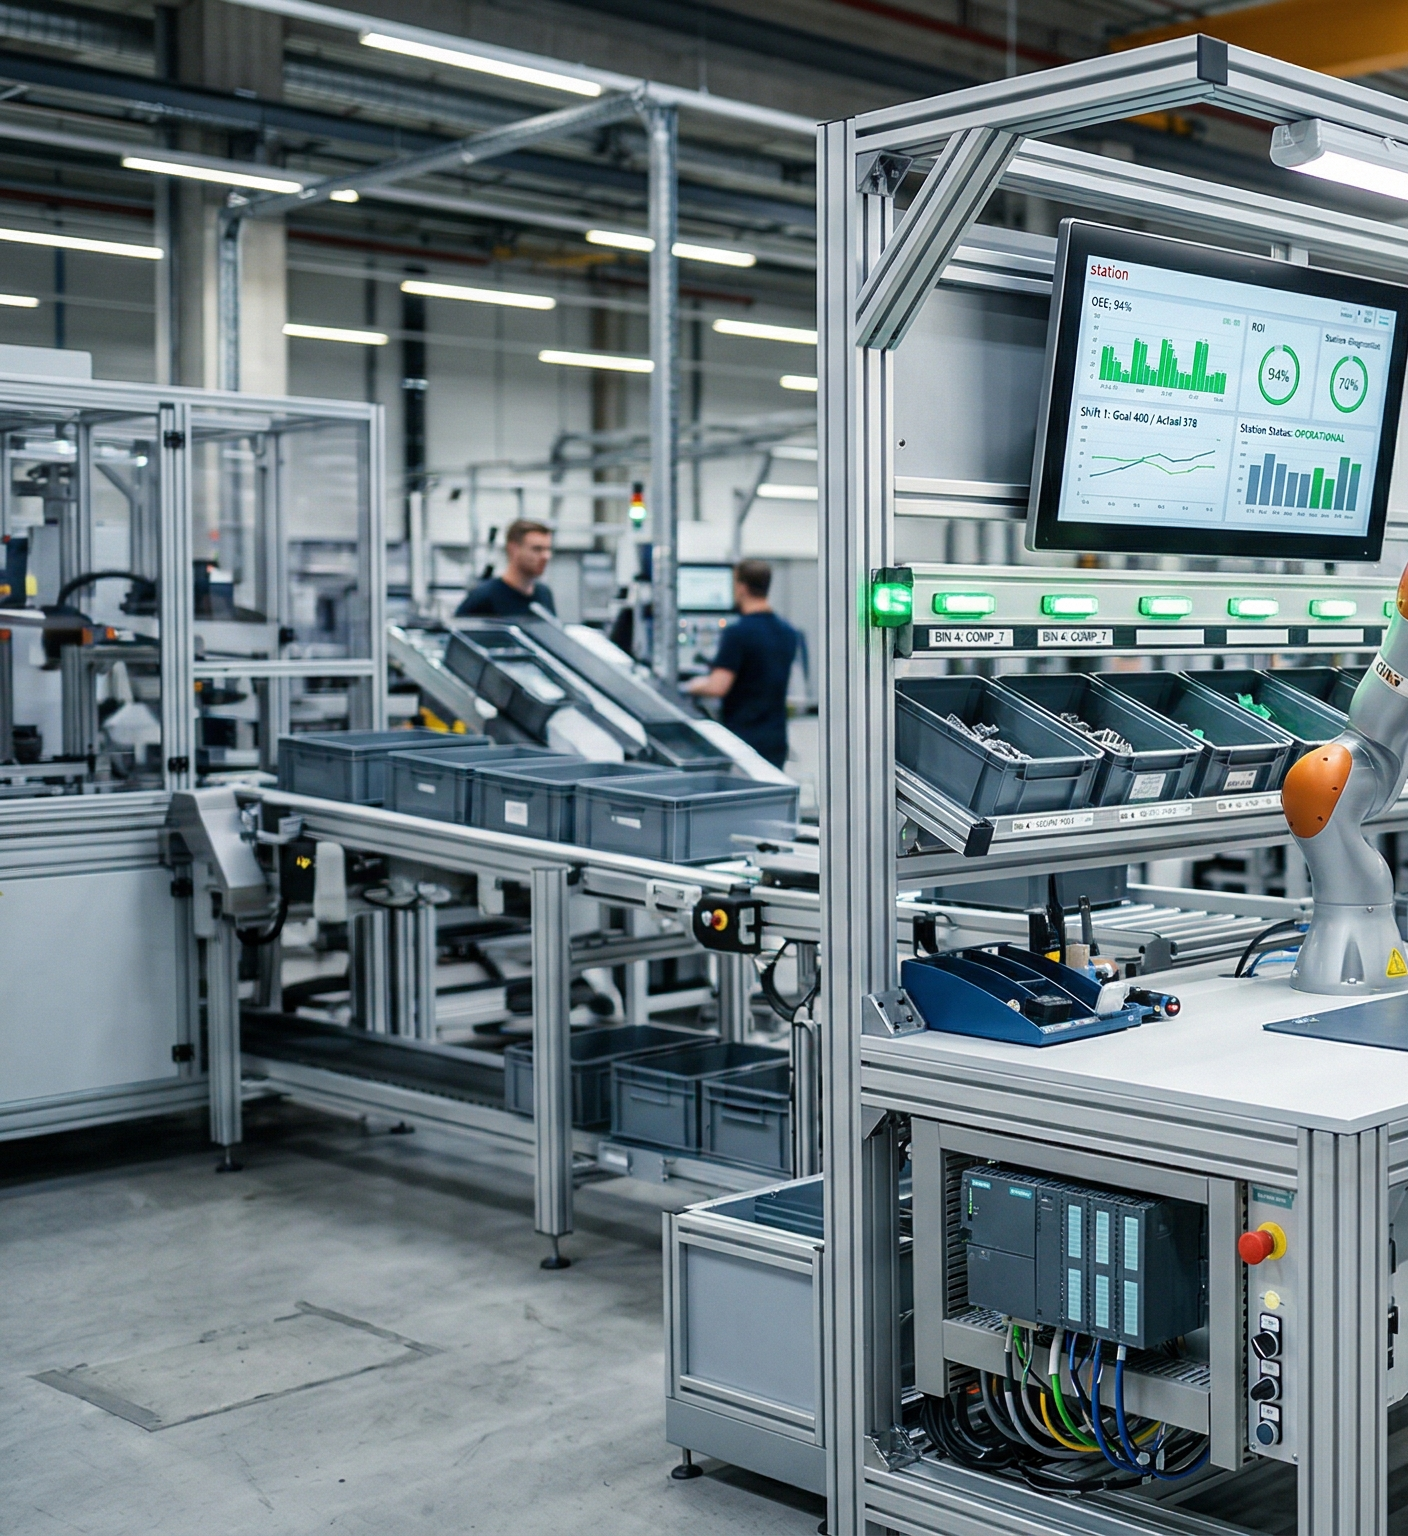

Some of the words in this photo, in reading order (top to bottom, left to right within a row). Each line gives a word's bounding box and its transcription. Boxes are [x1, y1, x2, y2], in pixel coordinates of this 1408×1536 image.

[1090, 263, 1129, 281] station
[1113, 299, 1133, 312] 94%
[1251, 322, 1266, 333] ROI
[1268, 367, 1290, 383] 94%
[1112, 410, 1132, 422] Goal
[1133, 413, 1149, 424] 400
[1182, 416, 1198, 428] 378
[935, 631, 951, 643] BIN
[965, 631, 1005, 645] COMP_7
[1042, 631, 1059, 642] BIN
